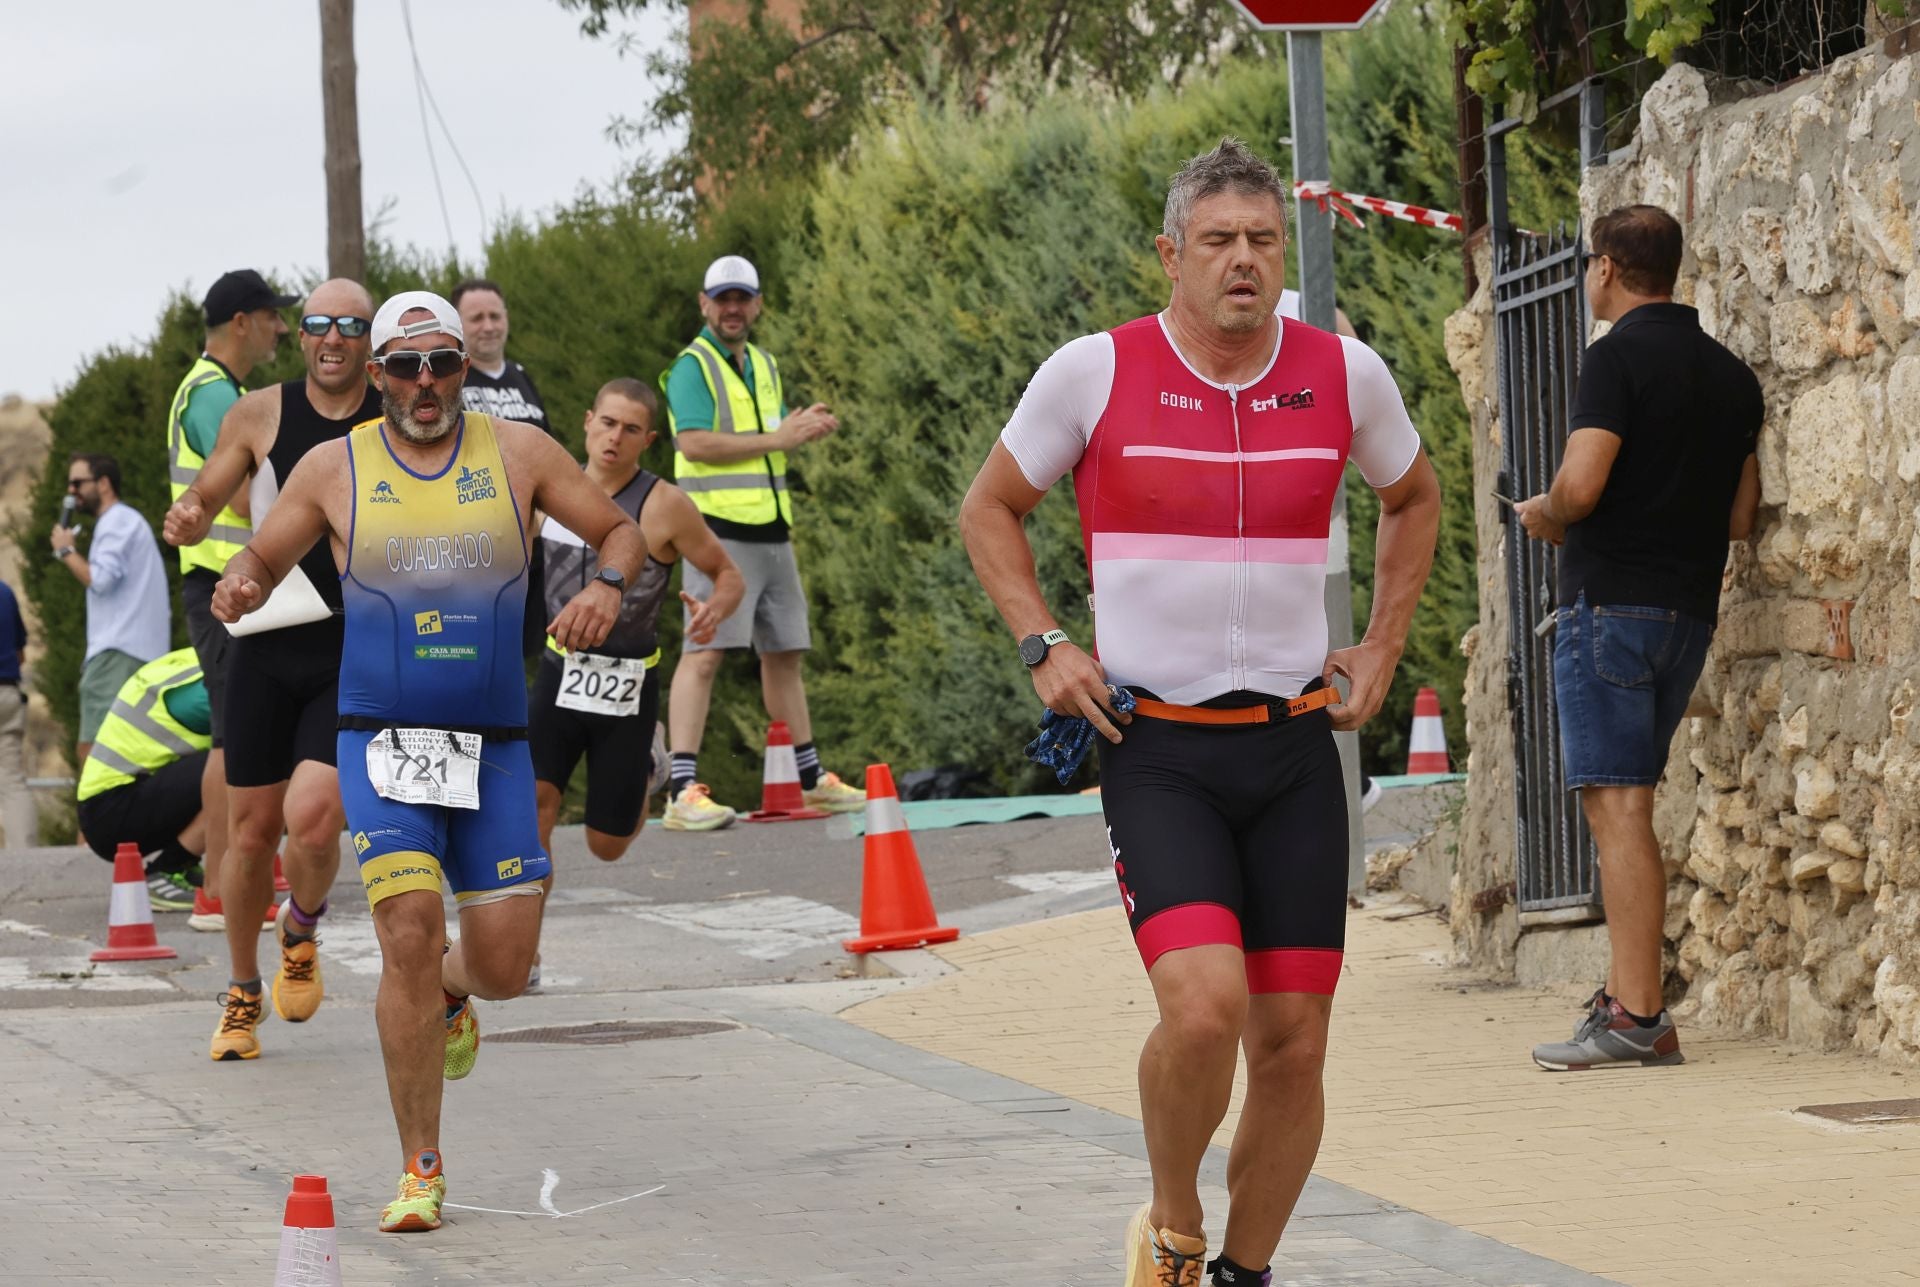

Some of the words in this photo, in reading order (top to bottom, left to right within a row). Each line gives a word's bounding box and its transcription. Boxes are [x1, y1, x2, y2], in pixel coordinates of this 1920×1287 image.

[1160, 391, 1203, 412] GOBIK
[456, 475, 494, 494] TRIATLON
[457, 486, 497, 505] DUERO
[386, 531, 493, 573] CUADRADO
[450, 647, 476, 655] RURAL
[564, 669, 637, 703] 2022
[385, 730, 452, 739] FDERACIO
[385, 743, 436, 751] CSTILLA
[449, 748, 477, 757] LON
[392, 754, 448, 784] 721
